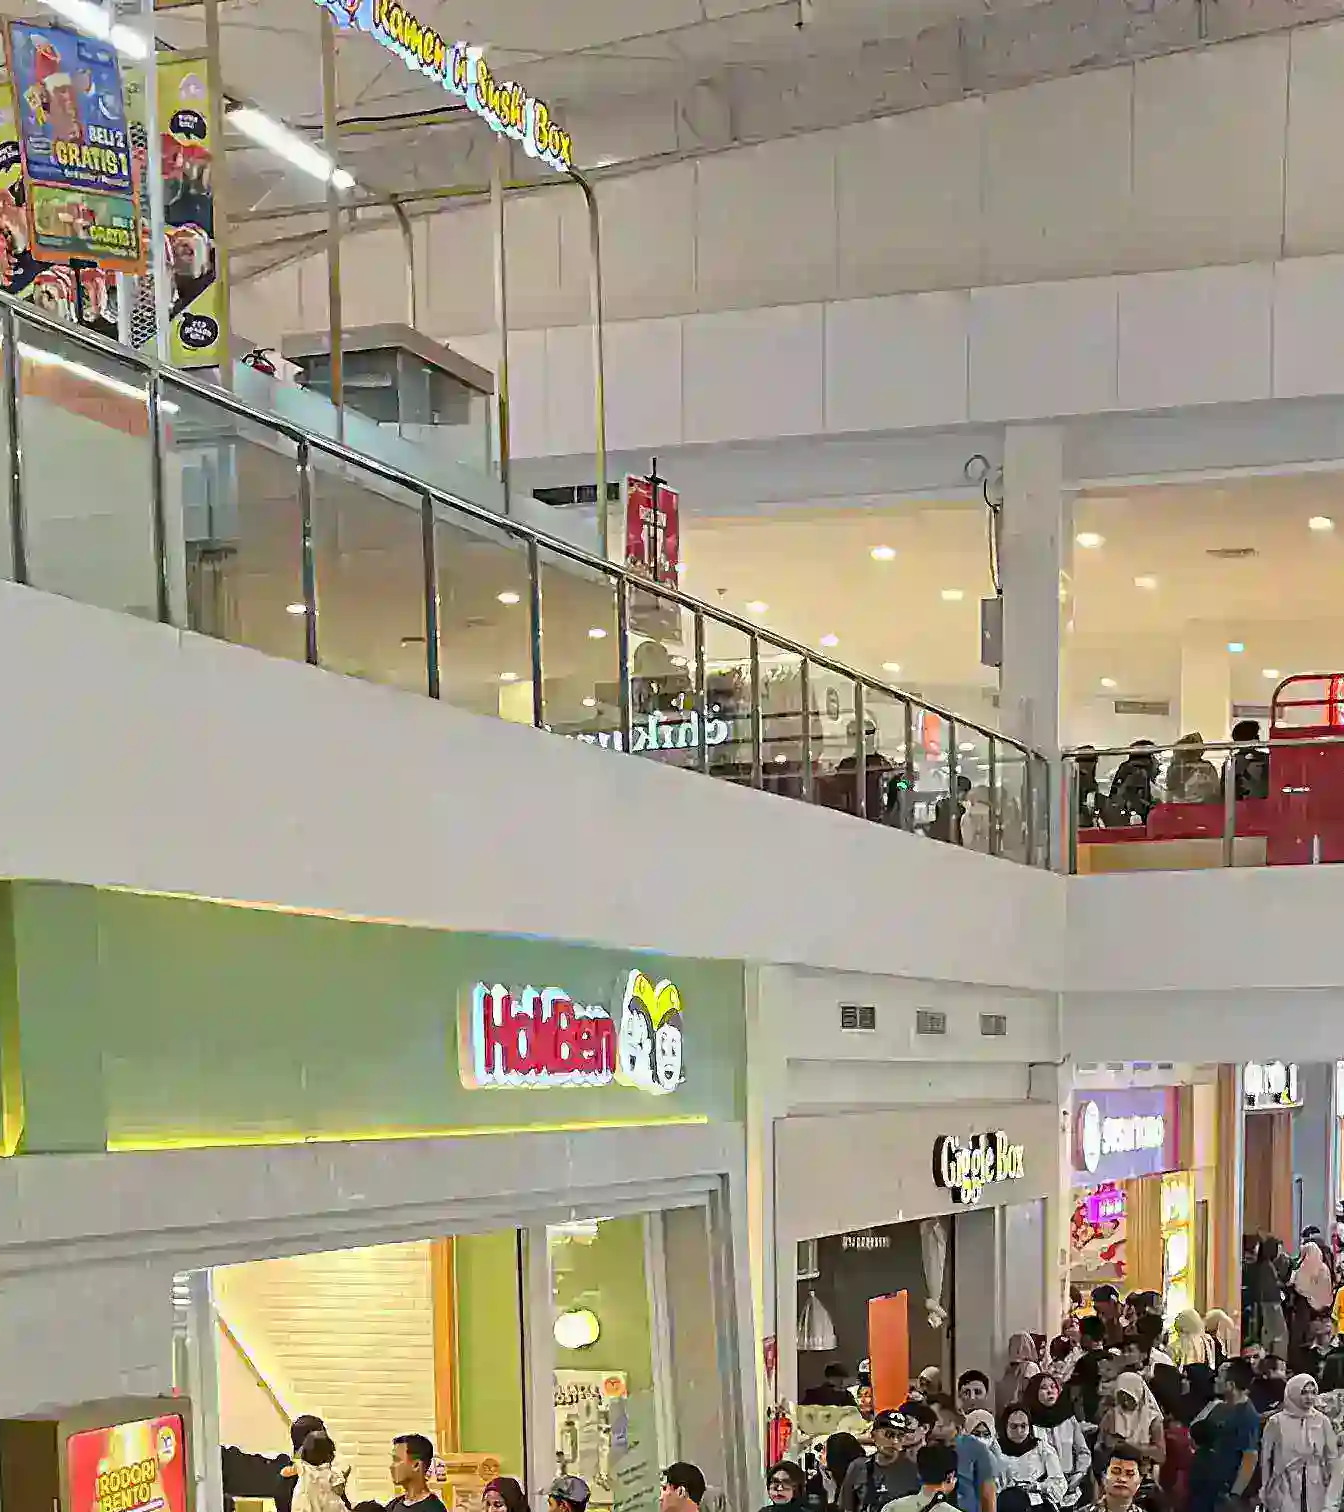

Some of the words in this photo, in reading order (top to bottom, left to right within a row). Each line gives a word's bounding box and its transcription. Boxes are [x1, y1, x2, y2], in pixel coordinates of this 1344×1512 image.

[475, 58, 528, 137] Sushi
[532, 99, 574, 168] Box
[56, 140, 118, 174] GRATIS
[474, 986, 618, 1081] HokBen
[995, 1130, 1024, 1181] Box
